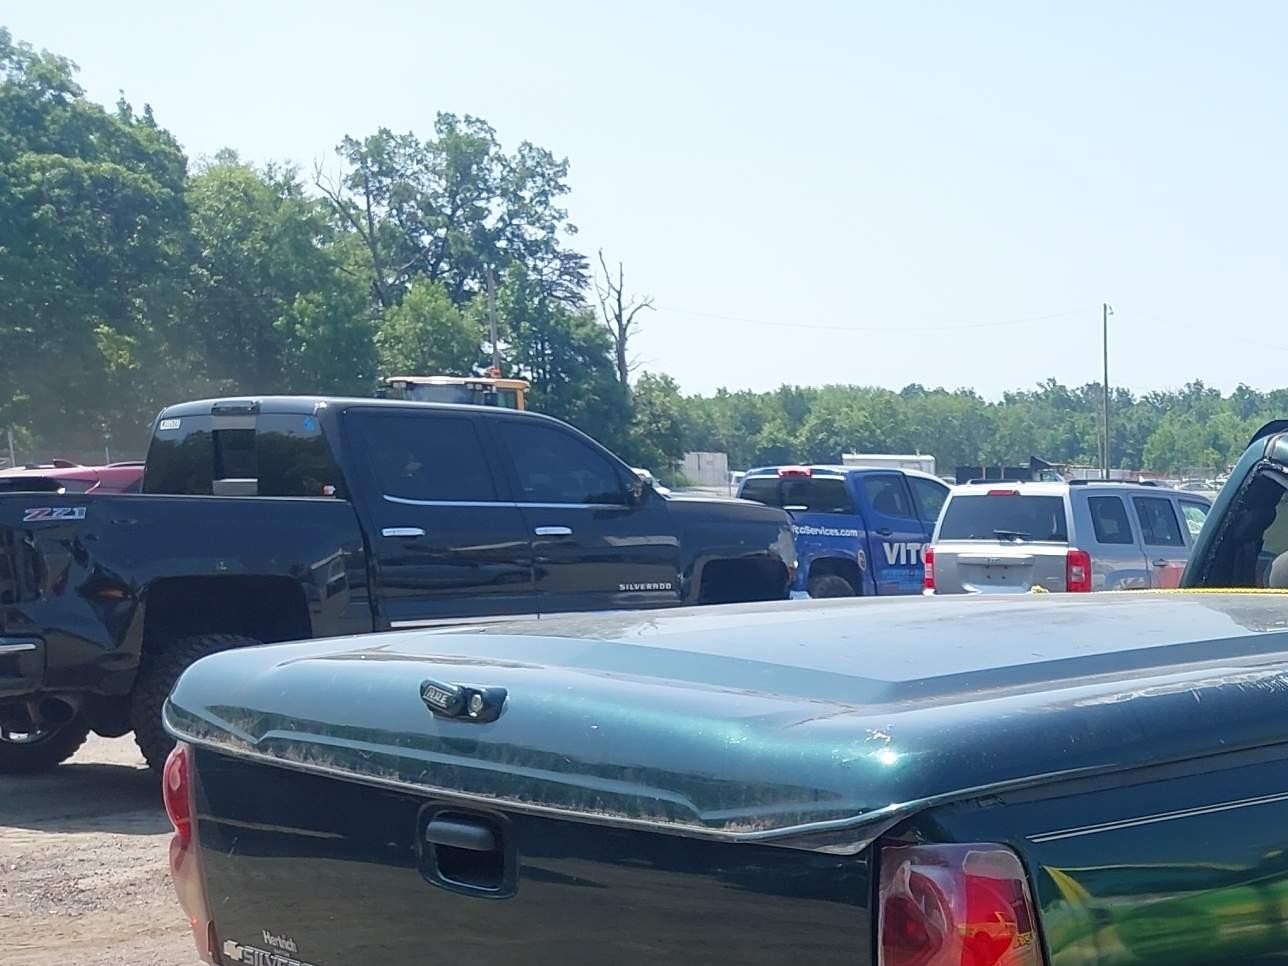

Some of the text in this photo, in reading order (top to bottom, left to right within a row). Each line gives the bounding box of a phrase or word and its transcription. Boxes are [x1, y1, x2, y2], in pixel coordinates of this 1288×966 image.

[23, 506, 87, 521] Z71
[618, 582, 673, 591] SILVERADO
[426, 687, 449, 704] ARE
